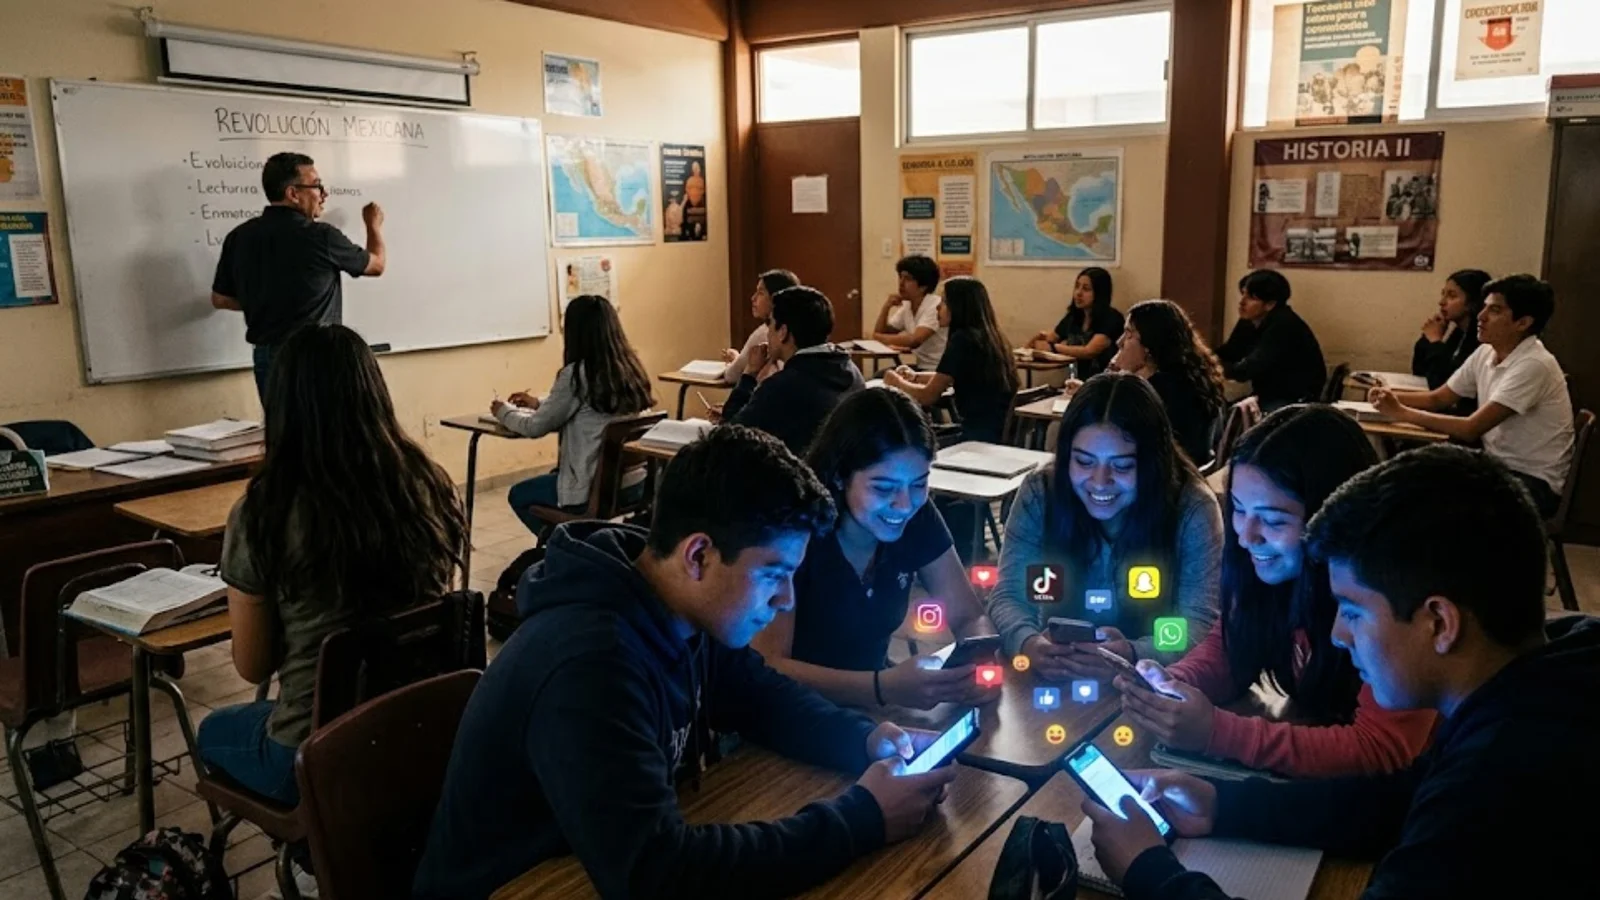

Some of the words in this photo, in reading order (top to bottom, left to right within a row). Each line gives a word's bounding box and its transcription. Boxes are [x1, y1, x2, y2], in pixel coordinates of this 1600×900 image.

[214, 106, 330, 136] REVOLUCIÓN
[343, 116, 425, 139] MEXICANA
[1283, 139, 1389, 160] HISTORIA
[1396, 138, 1411, 157] II
